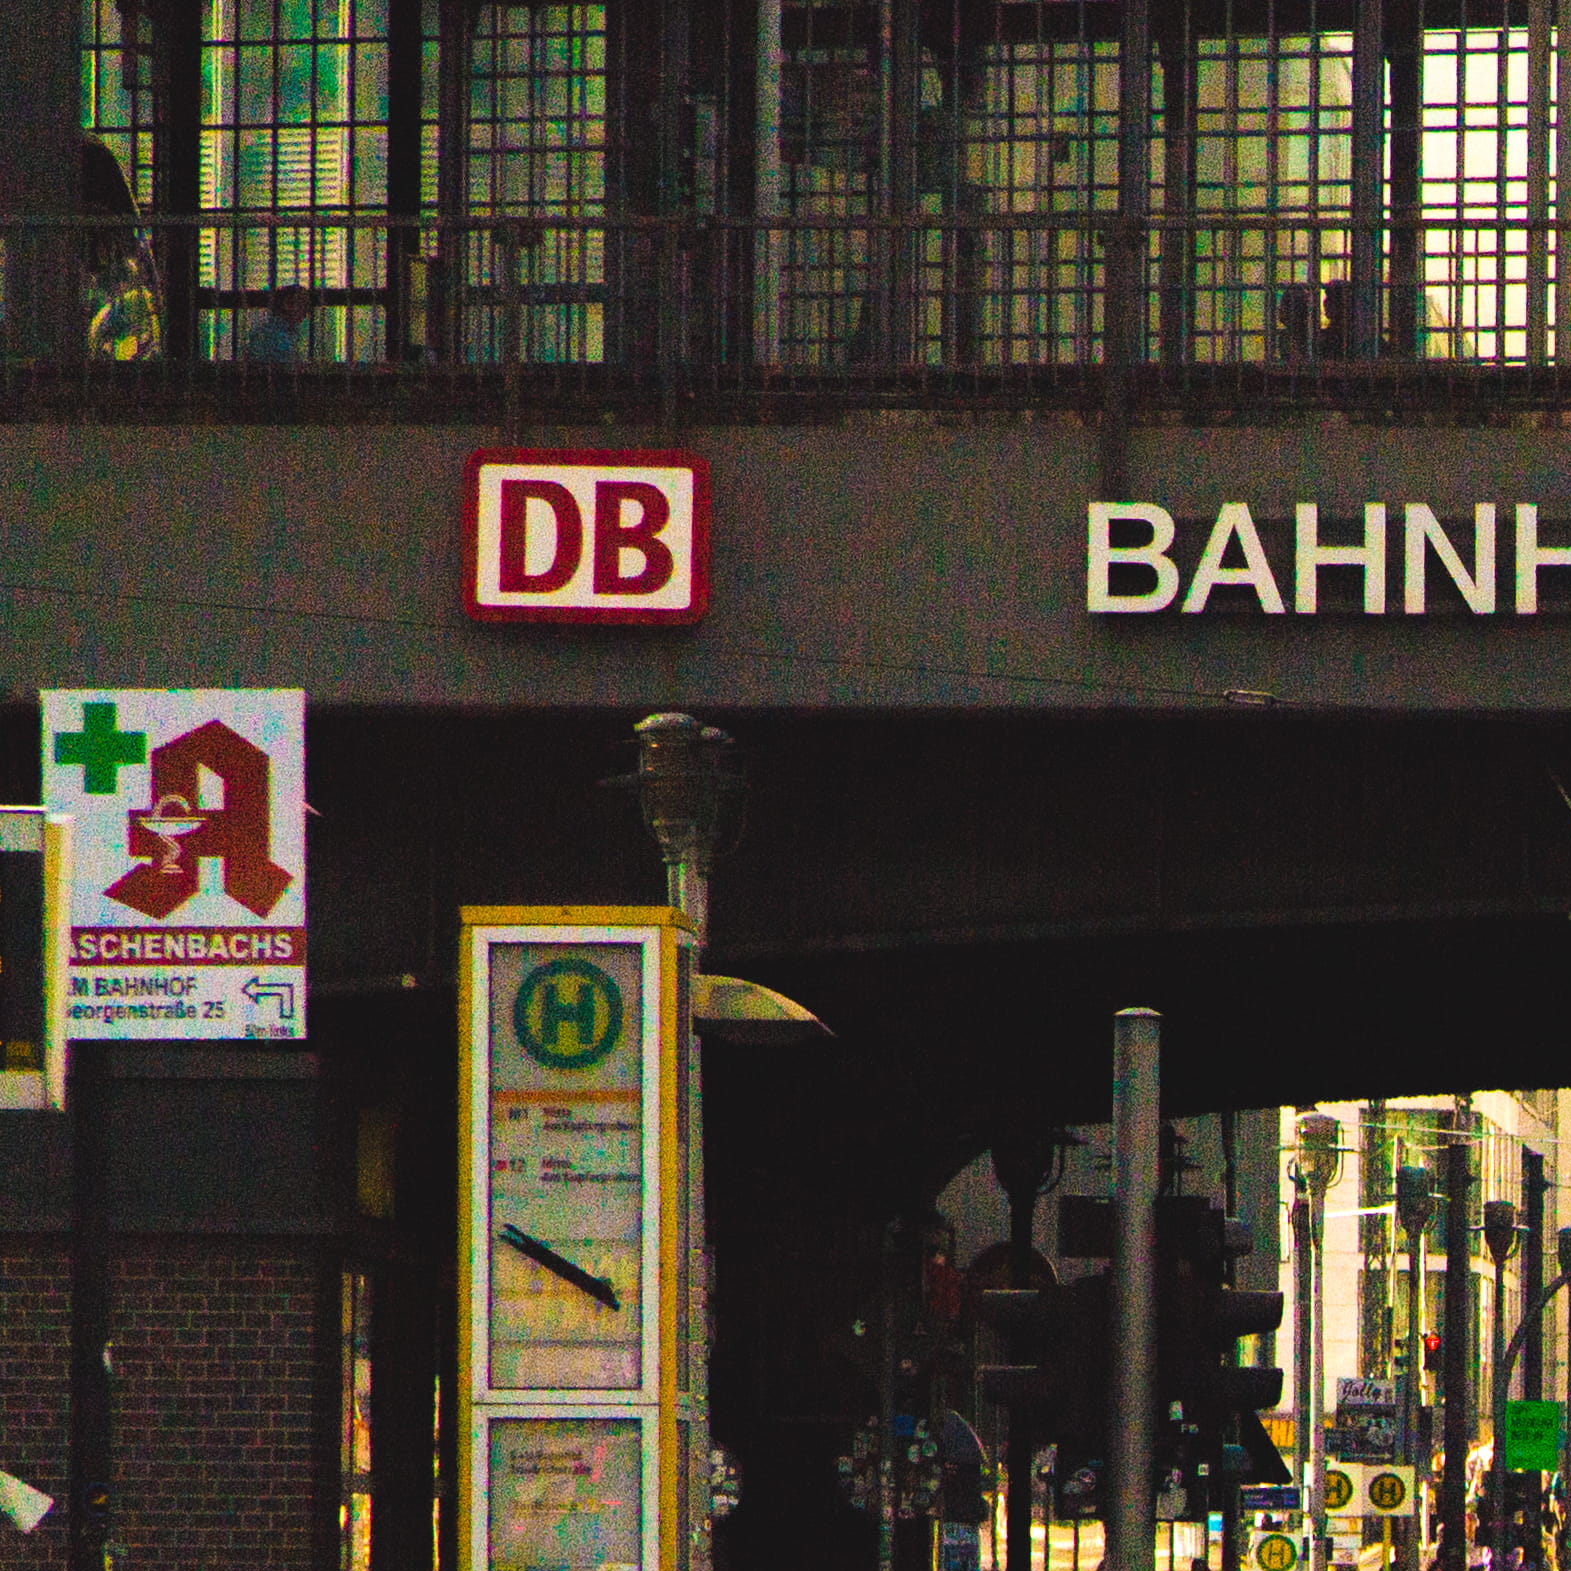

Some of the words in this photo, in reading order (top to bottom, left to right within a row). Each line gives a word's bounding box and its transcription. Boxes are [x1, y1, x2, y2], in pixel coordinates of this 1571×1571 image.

[499, 479, 675, 595] DB
[67, 977, 89, 996] M
[94, 976, 198, 997] BAHNHOF
[66, 1001, 197, 1024] eorgenstraße
[202, 1001, 226, 1019] 25
